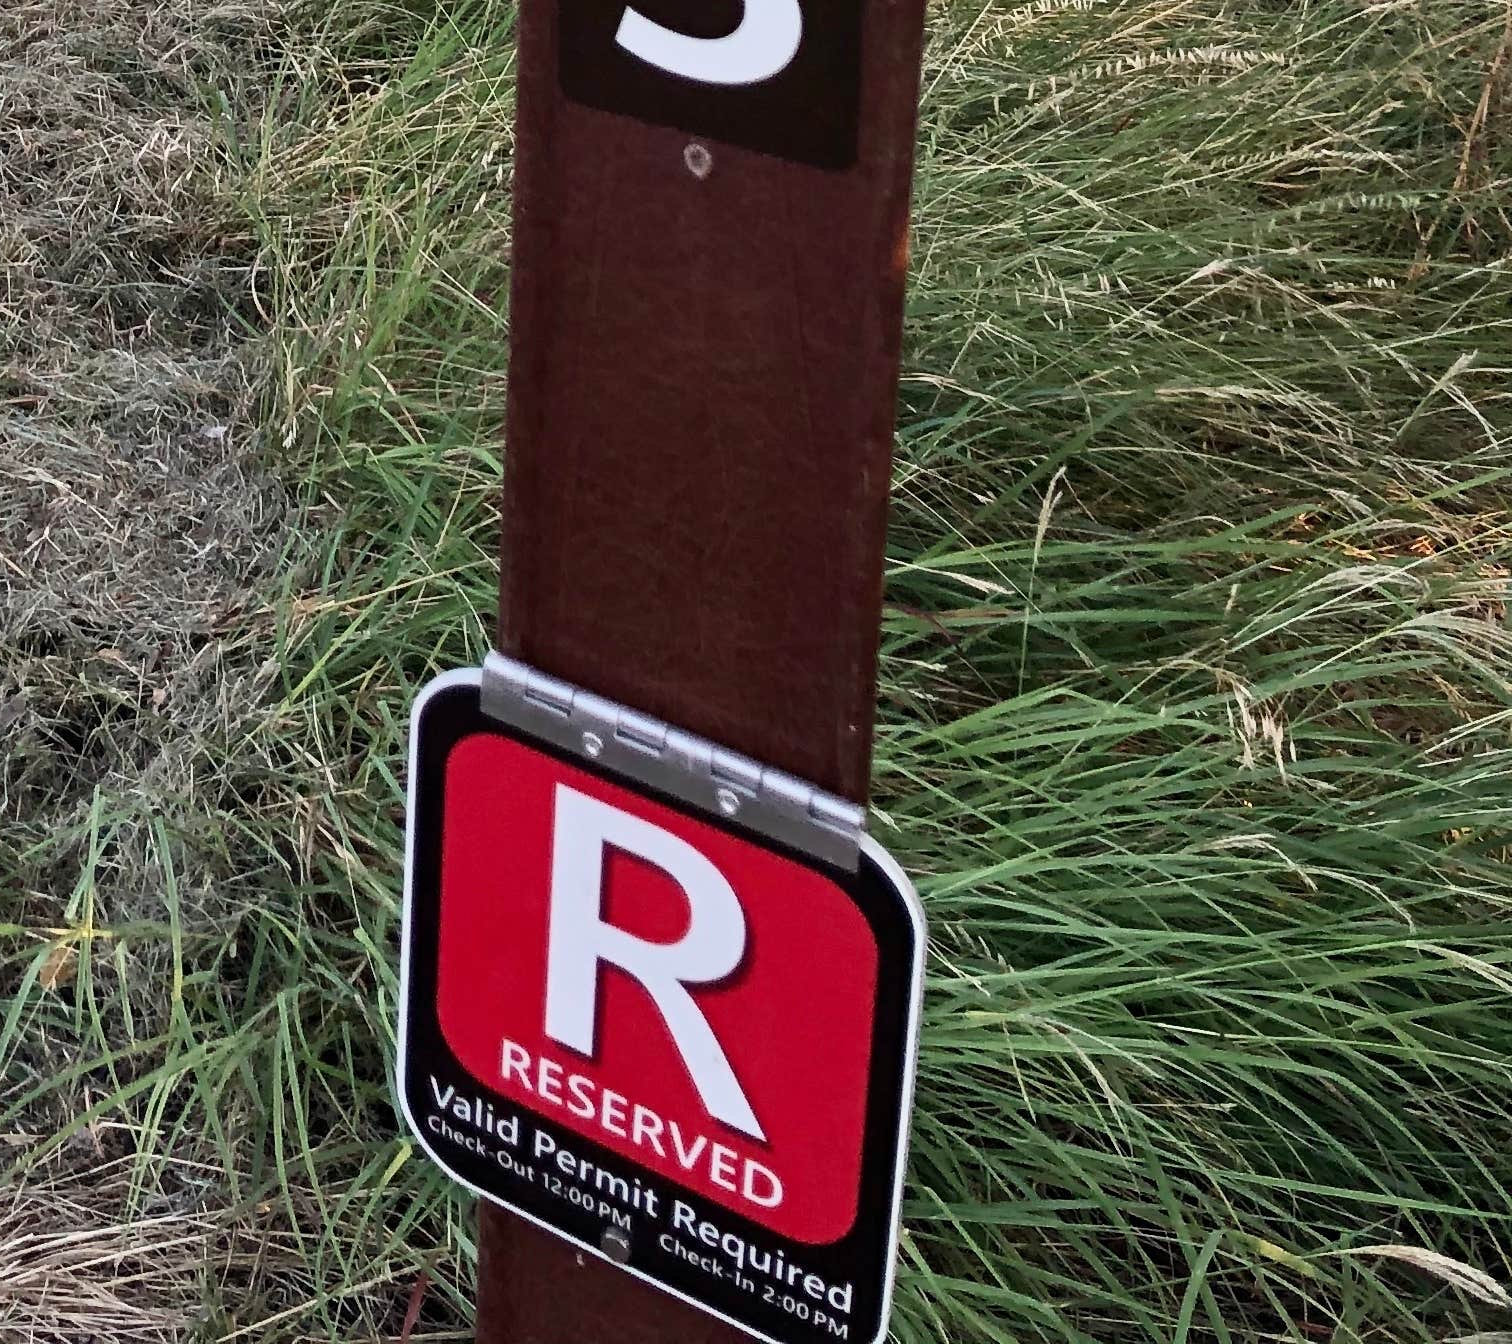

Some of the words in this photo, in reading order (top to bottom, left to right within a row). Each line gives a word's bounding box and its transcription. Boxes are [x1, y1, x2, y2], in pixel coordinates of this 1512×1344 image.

[544, 782, 767, 1142] R
[427, 1114, 535, 1183] Check-Out
[542, 1171, 595, 1211] 12:00
[598, 1200, 632, 1231] PM
[429, 1074, 520, 1147] Valid
[533, 1129, 659, 1219] Permit
[673, 1199, 854, 1315] Required
[500, 1037, 785, 1208] RESERVED
[659, 1232, 756, 1294] Check-In
[762, 1284, 810, 1320] 2:00
[813, 1309, 849, 1341] PM
